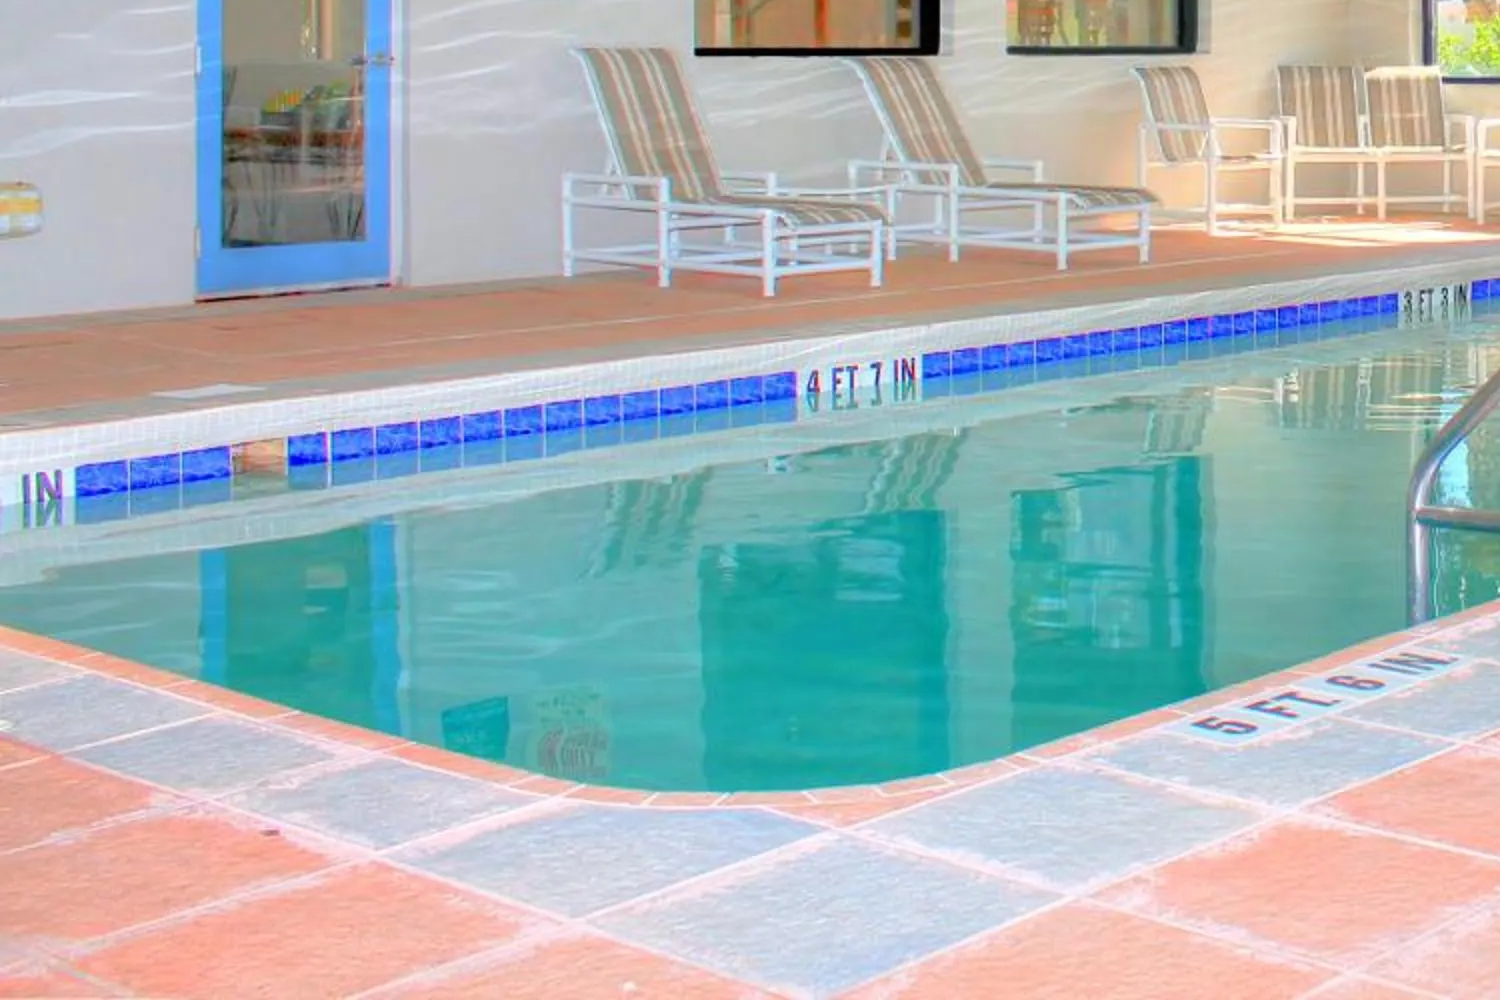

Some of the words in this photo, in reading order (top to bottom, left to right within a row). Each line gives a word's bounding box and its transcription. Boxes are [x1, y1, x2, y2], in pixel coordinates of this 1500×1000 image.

[1453, 284, 1468, 306] IN
[805, 370, 821, 394] 4
[869, 360, 883, 387] 7
[893, 356, 916, 383] IN
[22, 469, 63, 505] IN
[1191, 714, 1259, 735] 5
